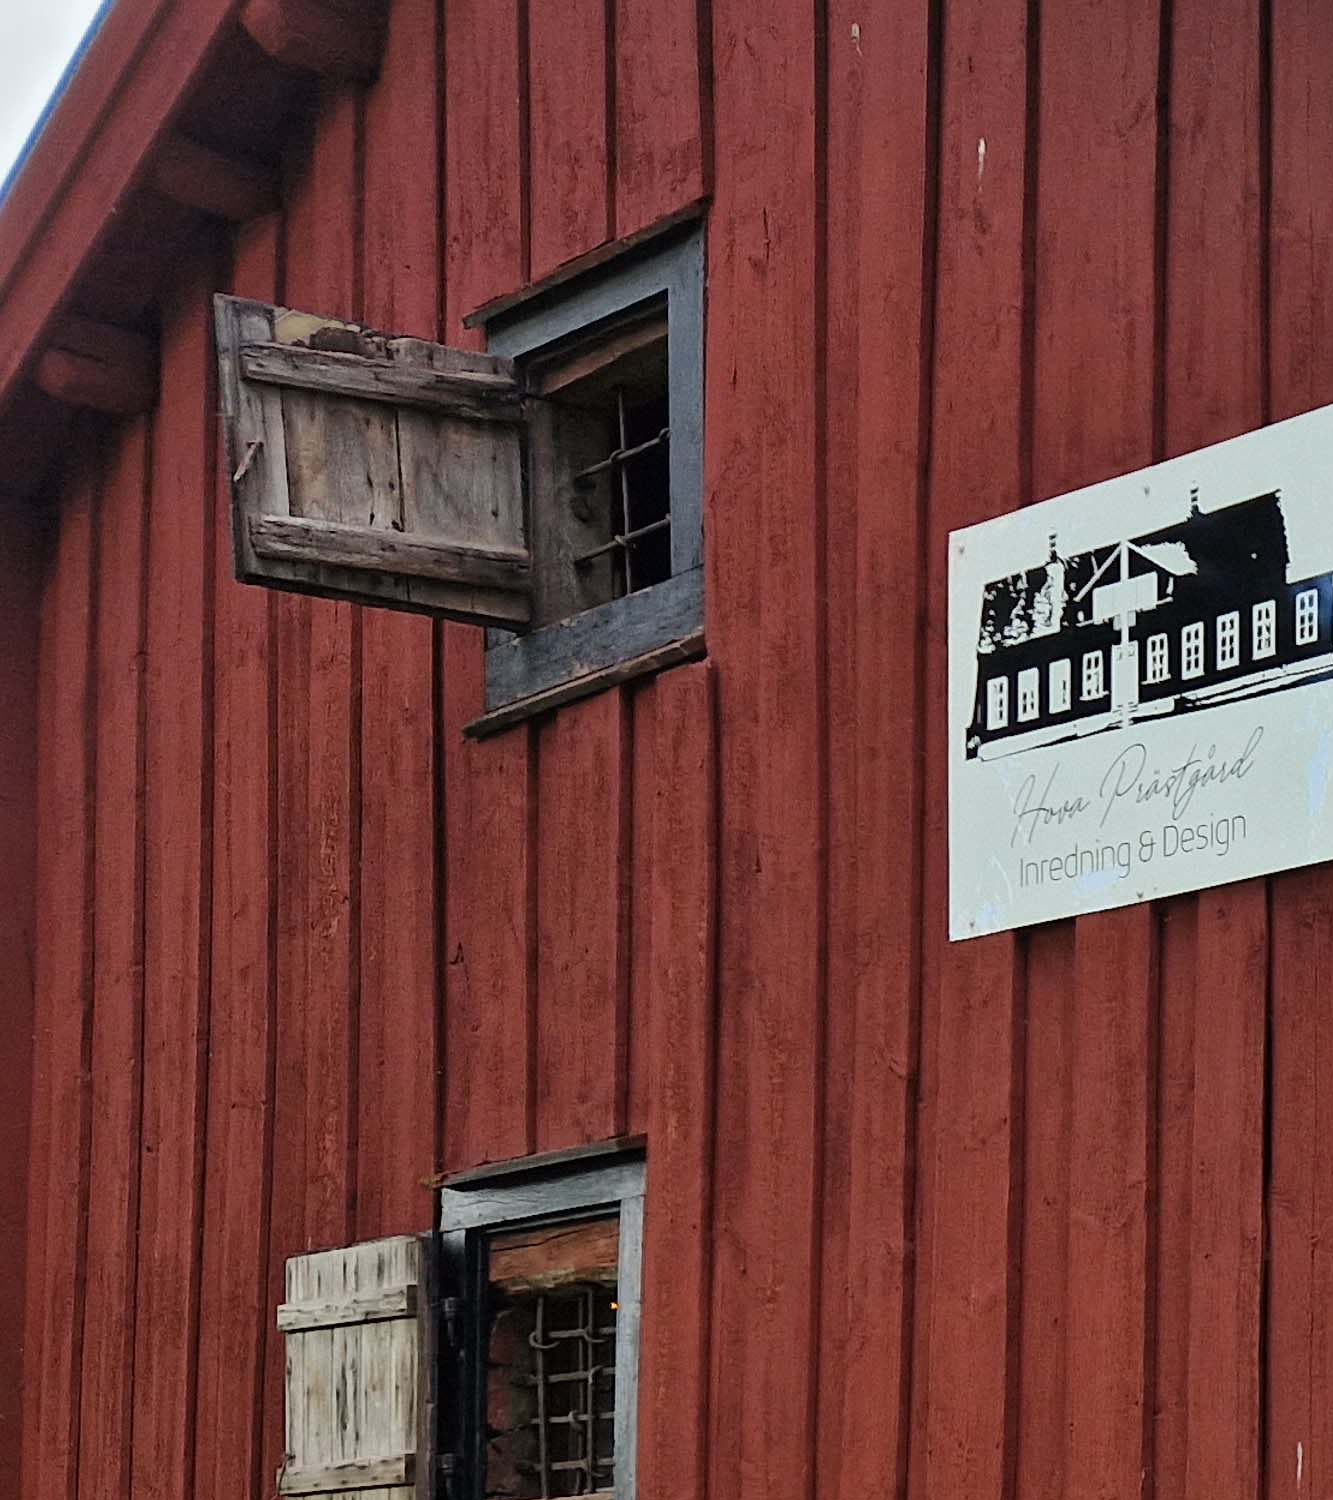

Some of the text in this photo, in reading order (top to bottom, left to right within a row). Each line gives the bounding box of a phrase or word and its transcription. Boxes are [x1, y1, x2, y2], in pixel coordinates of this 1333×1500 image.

[1099, 726, 1264, 828] Prästgård
[1020, 813, 1247, 888] Inredning & Design
